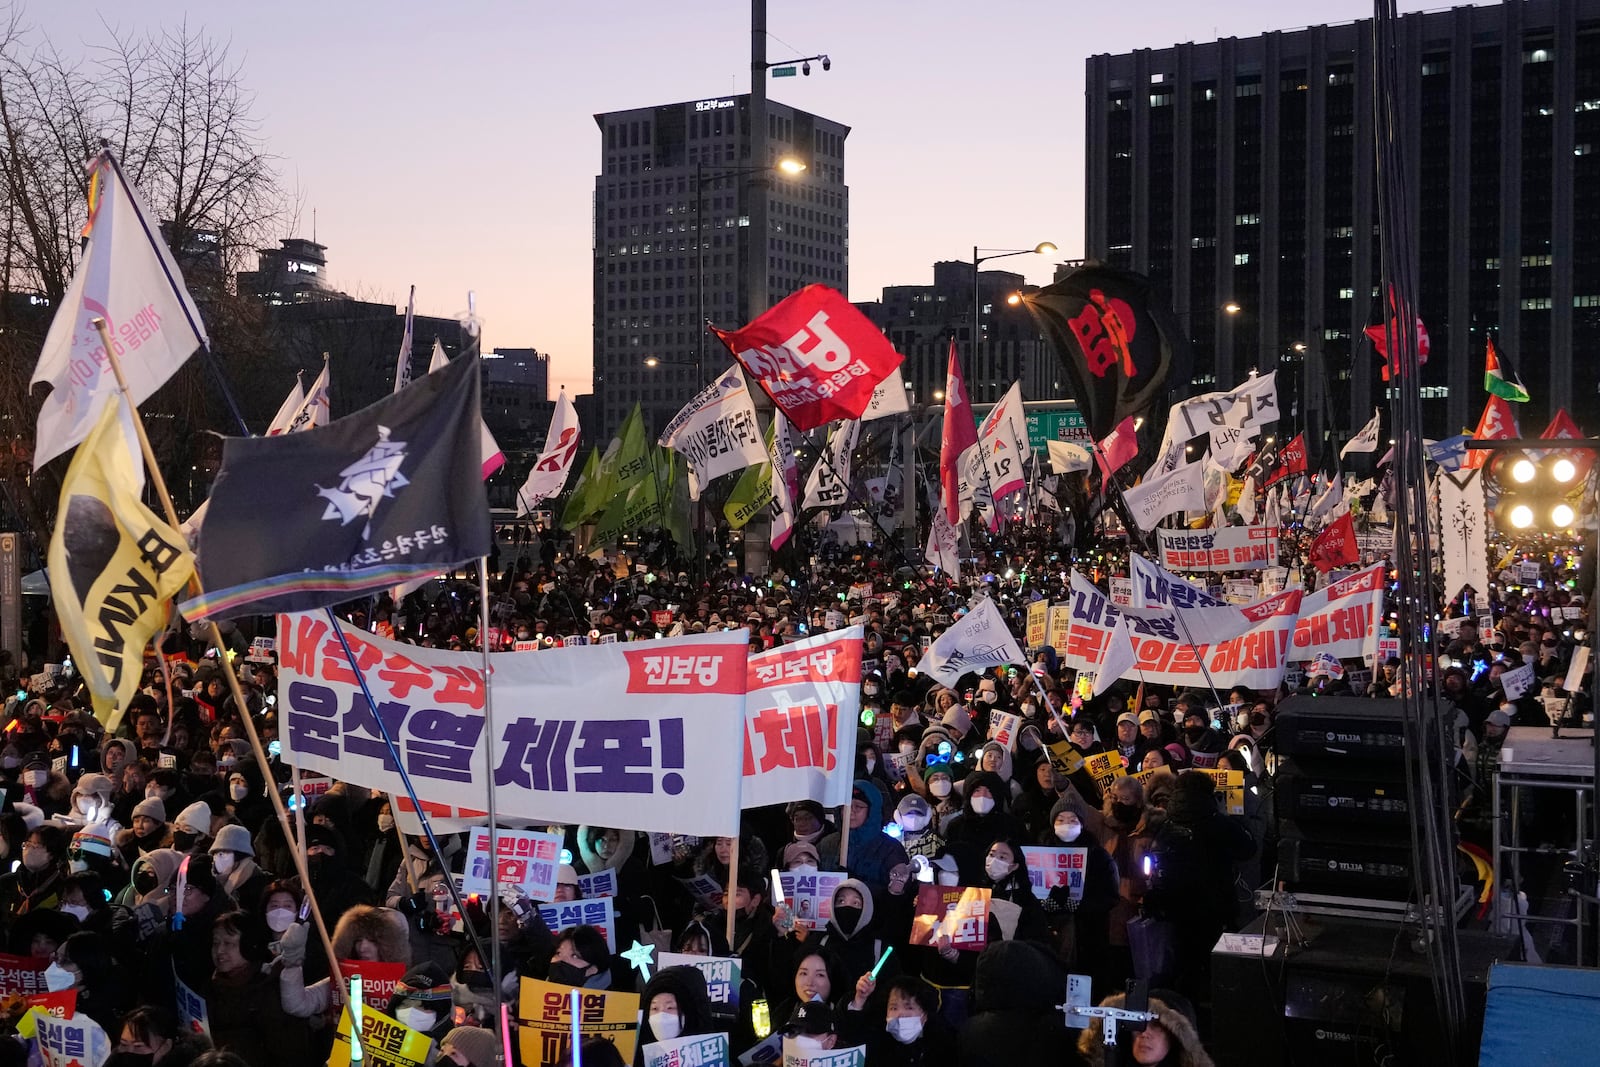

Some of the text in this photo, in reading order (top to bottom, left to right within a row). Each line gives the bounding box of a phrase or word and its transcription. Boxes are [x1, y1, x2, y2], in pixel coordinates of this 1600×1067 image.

[696, 100, 718, 111] 외교부
[738, 310, 851, 394] 진보당
[1166, 543, 1276, 567] 국민의힘 해체!
[1334, 573, 1373, 596] 진보당
[1254, 597, 1287, 617] 진보당
[1293, 603, 1374, 649] 해체!
[754, 649, 838, 685] 진보당
[1210, 629, 1289, 673] 해체!
[642, 653, 722, 687] 진보당
[288, 681, 686, 797] 윤석열 체포!
[1091, 754, 1111, 774] 윤석열
[475, 834, 557, 861] 국민의힘
[543, 992, 606, 1023] 윤석열
[37, 1018, 84, 1058] 윤석열
[362, 1015, 407, 1054] 윤석열
[681, 1036, 724, 1067] 체포!
